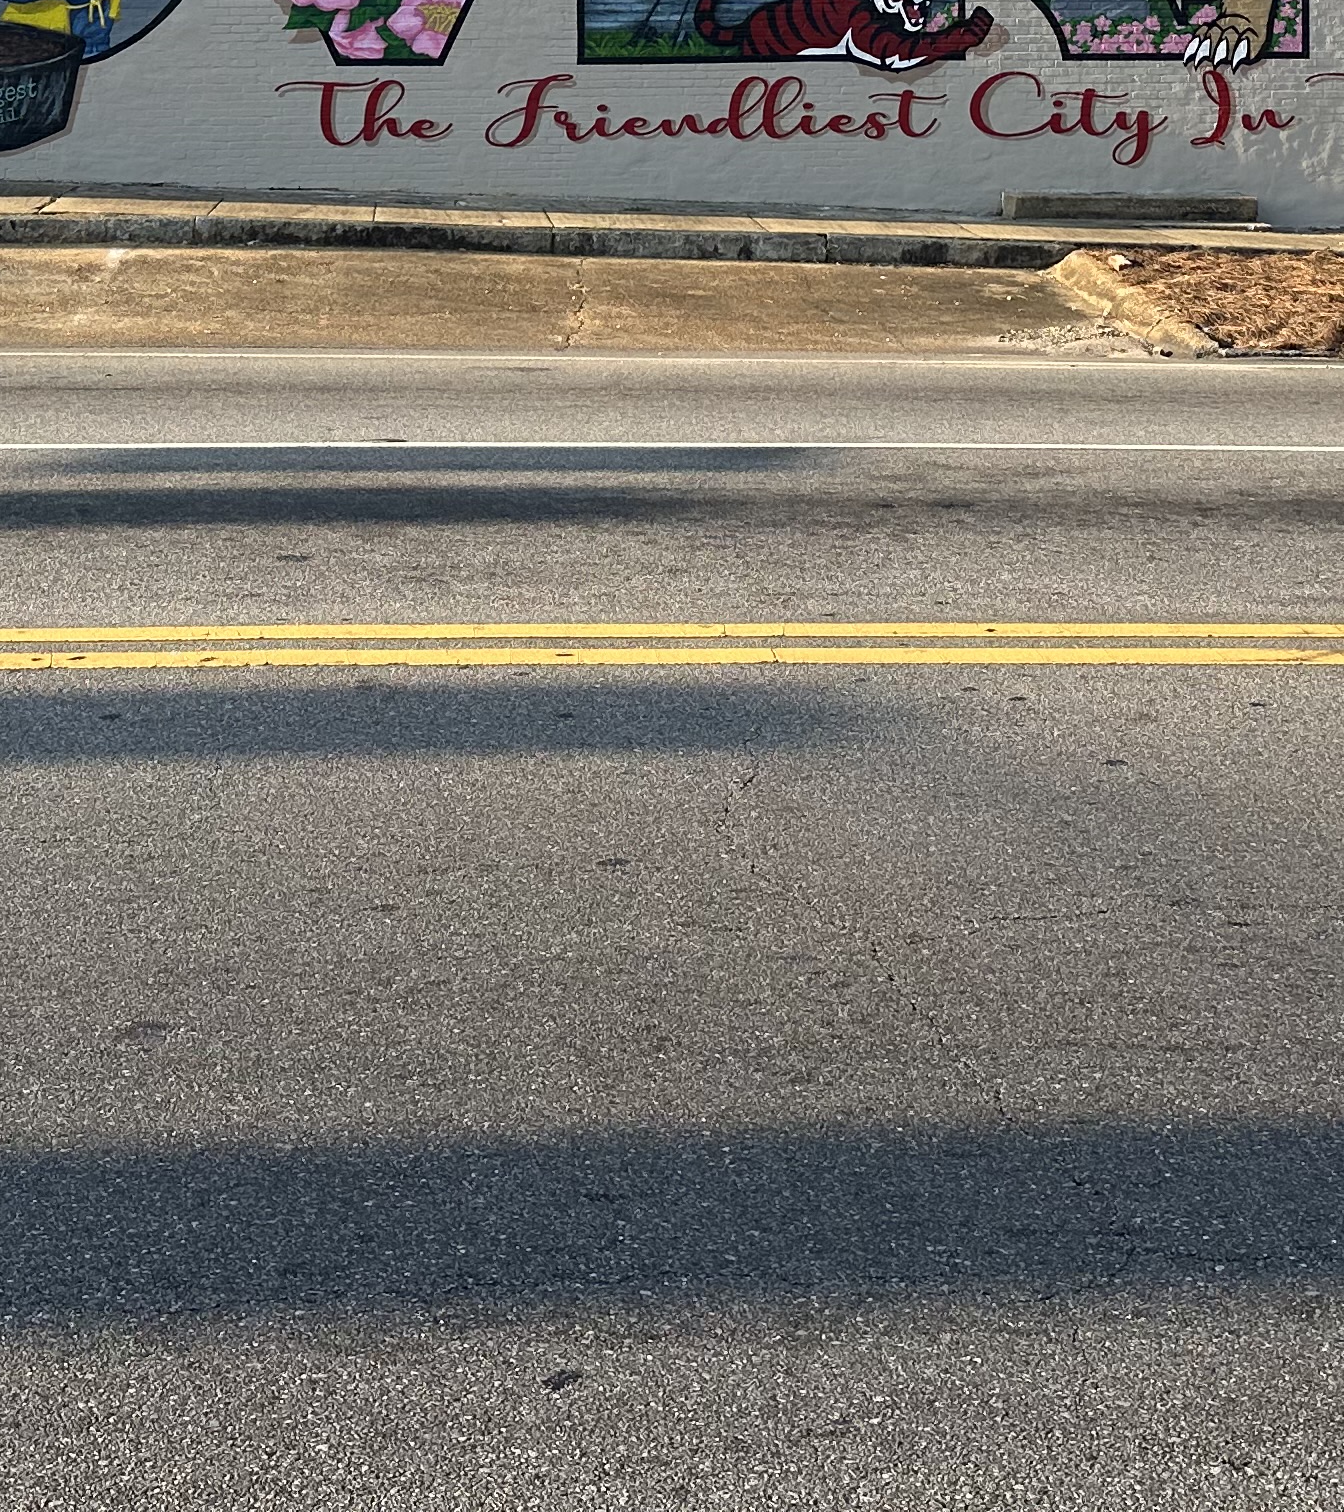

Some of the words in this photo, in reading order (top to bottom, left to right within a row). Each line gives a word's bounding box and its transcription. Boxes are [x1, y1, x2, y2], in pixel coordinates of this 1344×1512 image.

[274, 77, 453, 147] The
[485, 74, 947, 147] Friendliest
[969, 71, 1168, 167] City
[1190, 70, 1296, 146] In
